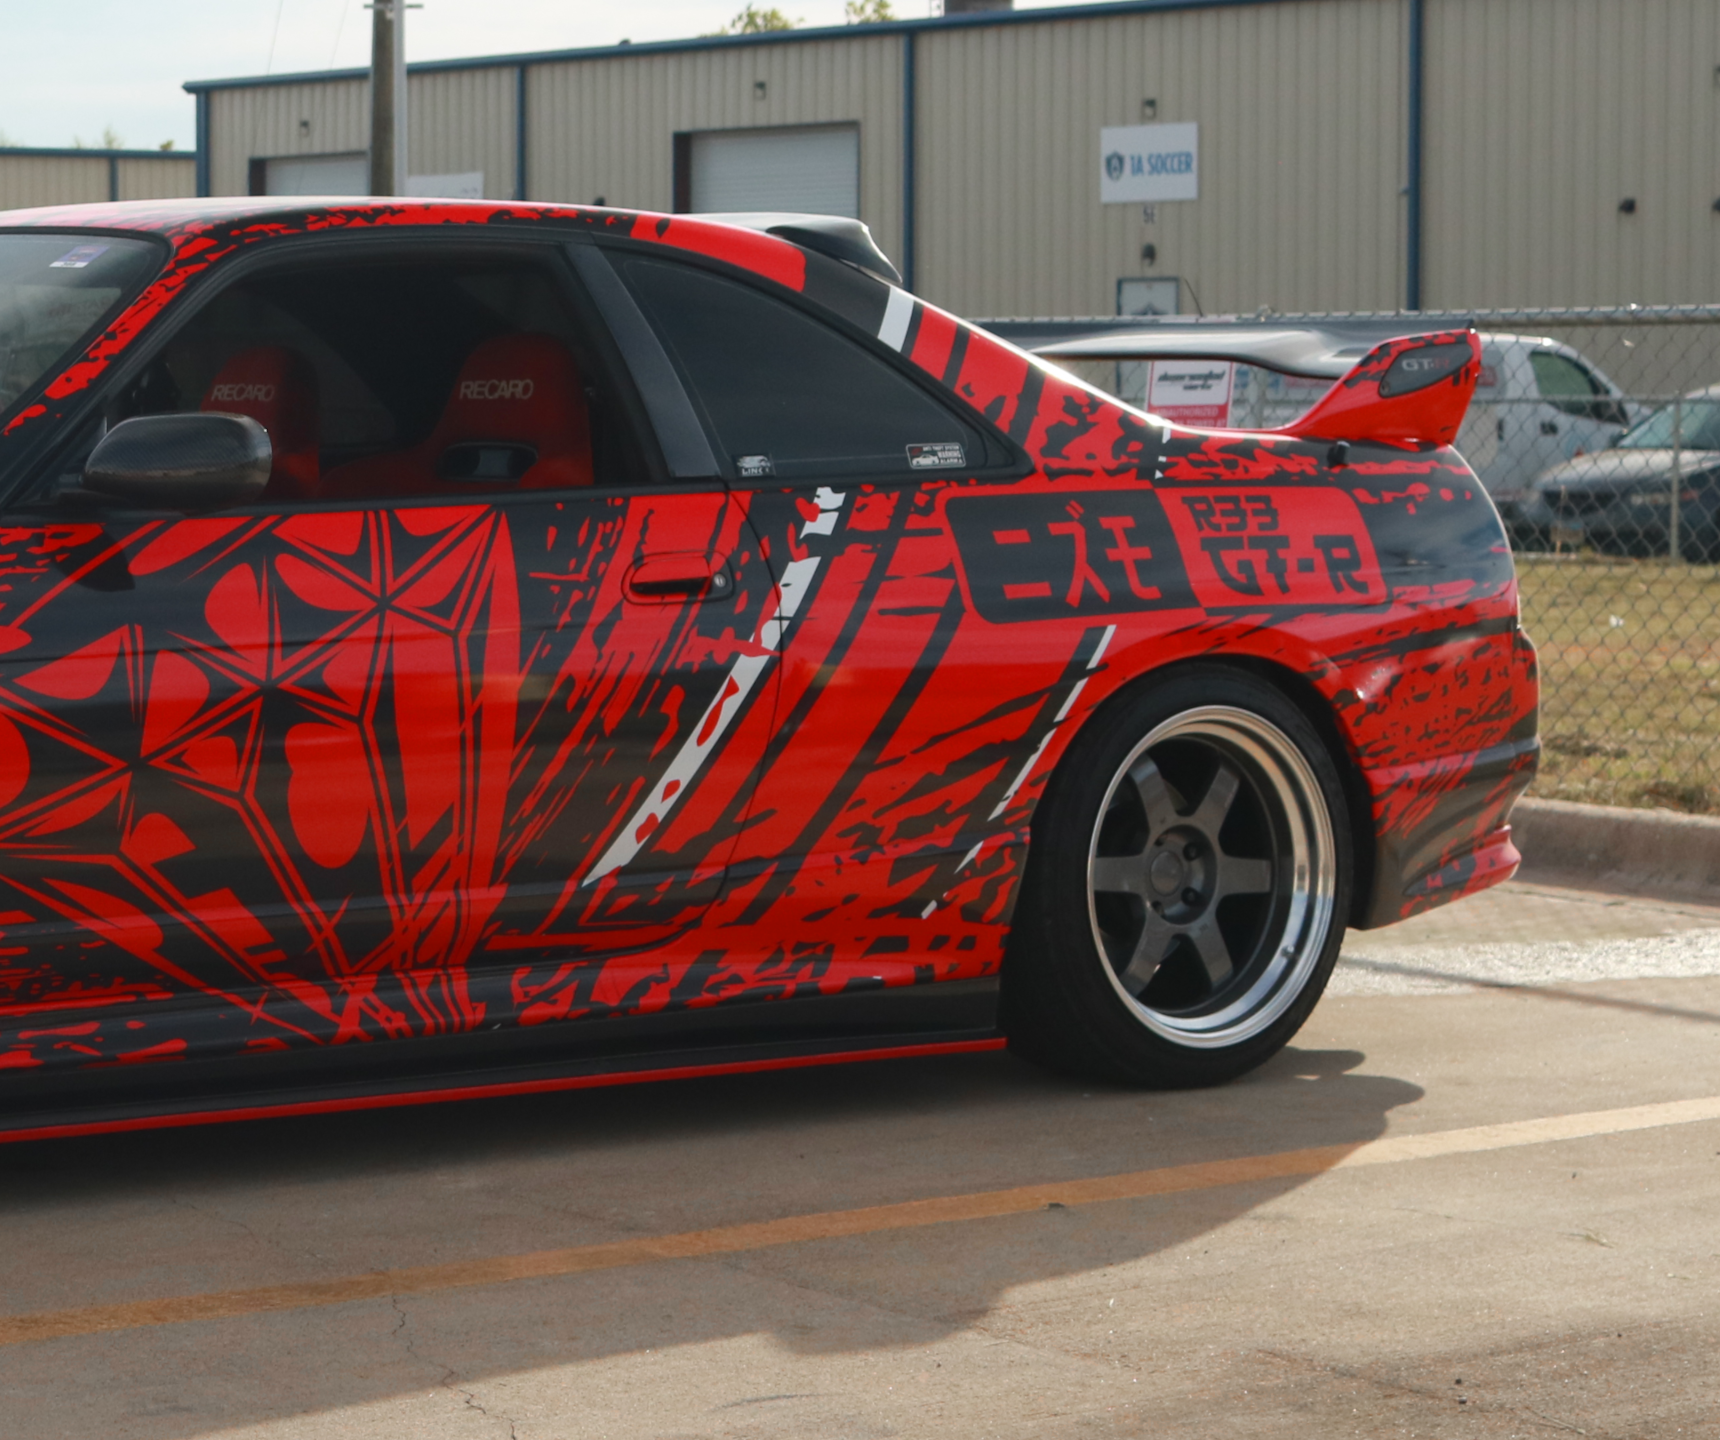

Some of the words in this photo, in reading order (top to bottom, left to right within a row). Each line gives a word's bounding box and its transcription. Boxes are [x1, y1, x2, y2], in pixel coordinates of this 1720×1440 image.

[1147, 151, 1193, 175] SOCCER
[211, 383, 275, 402] RECARO
[459, 379, 534, 400] RECARO
[1182, 494, 1280, 532] R33
[1200, 534, 1371, 597] GT-R
